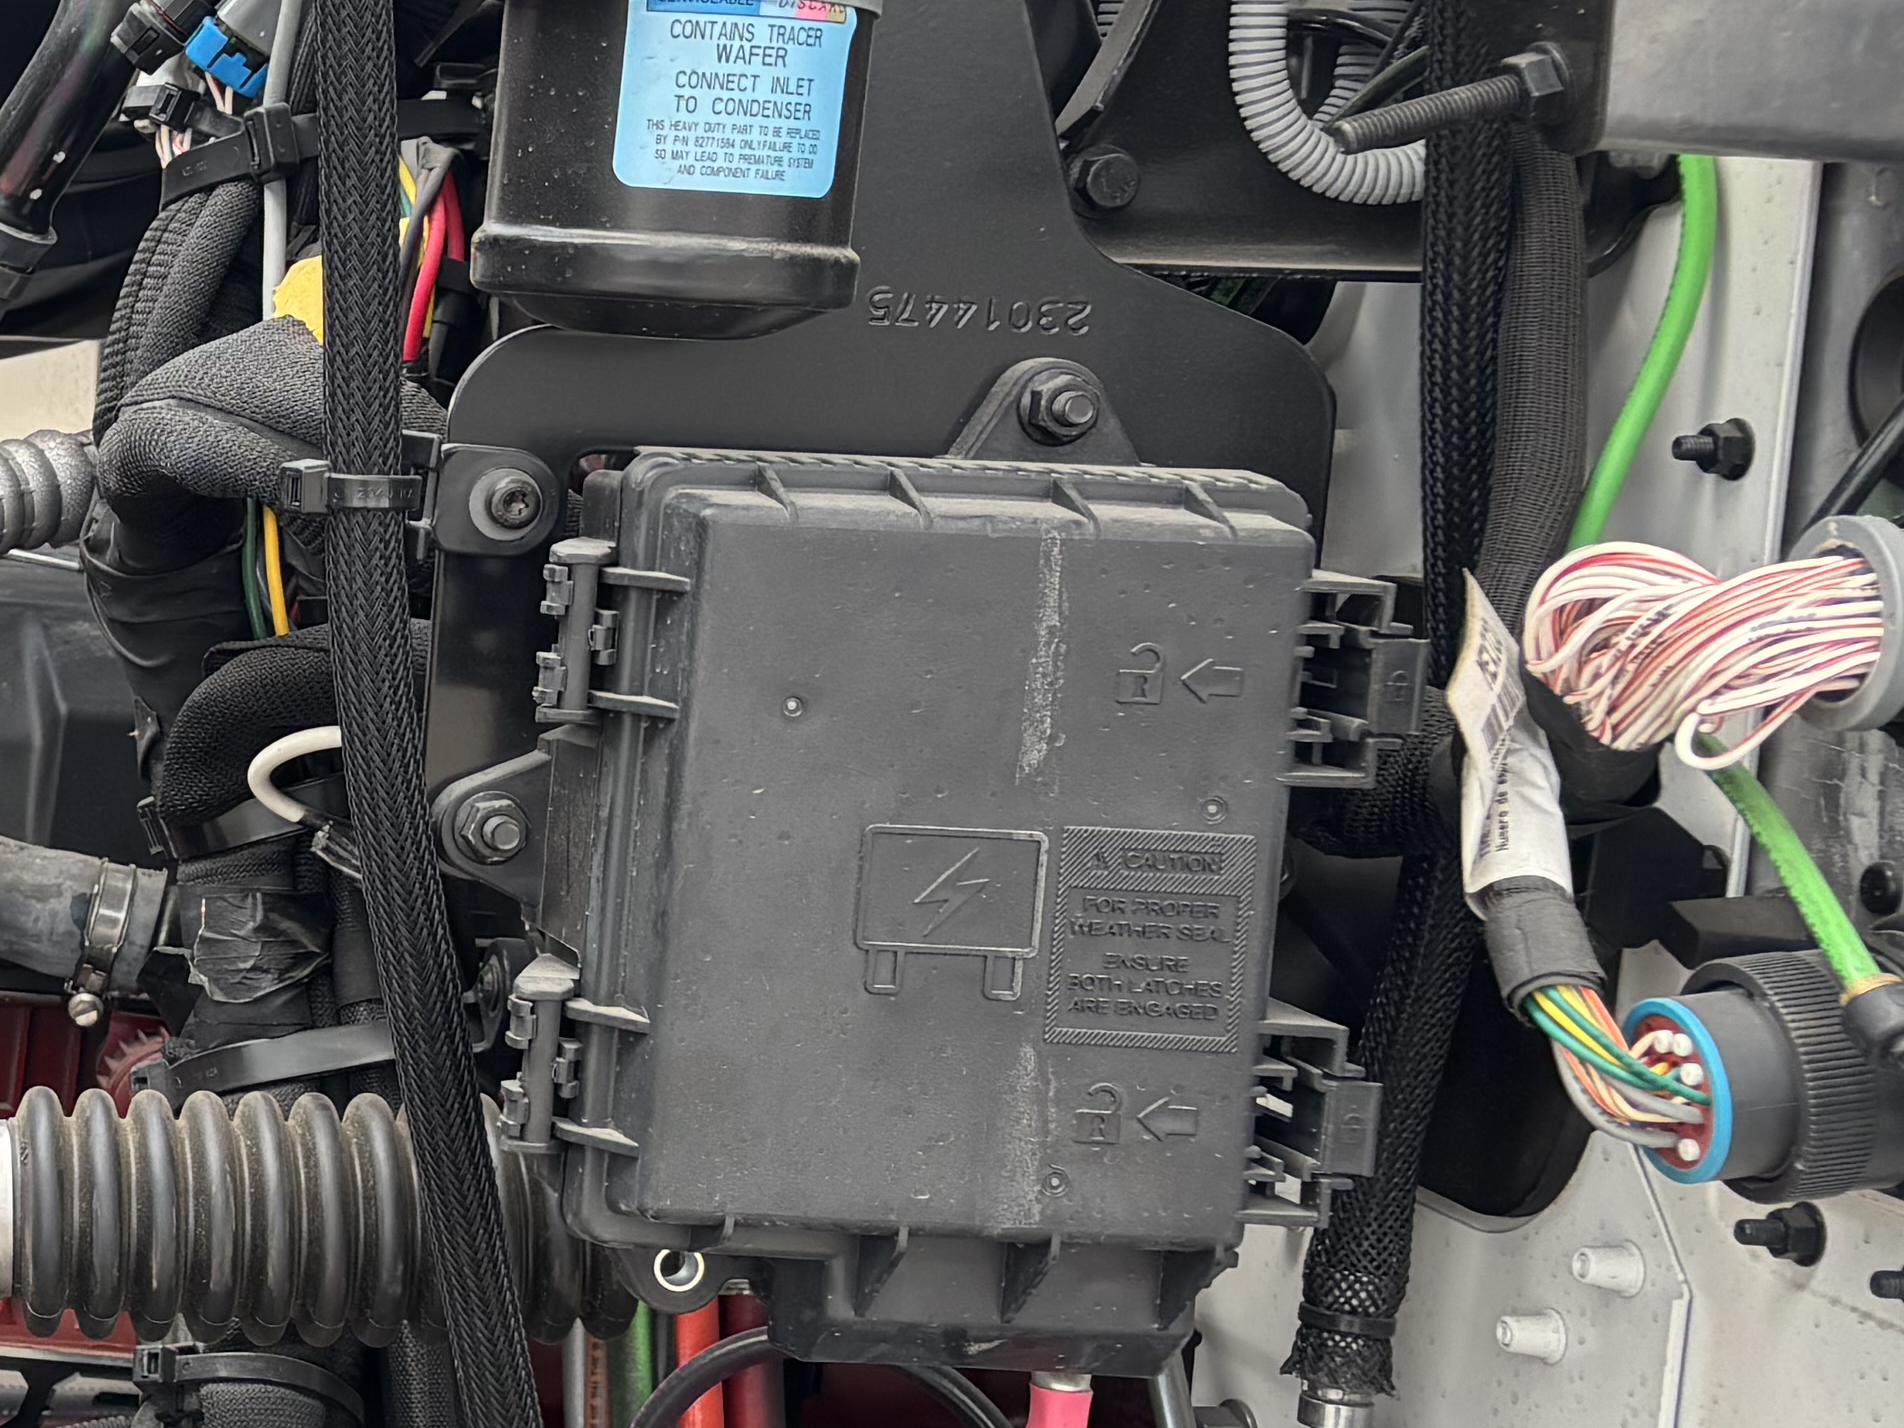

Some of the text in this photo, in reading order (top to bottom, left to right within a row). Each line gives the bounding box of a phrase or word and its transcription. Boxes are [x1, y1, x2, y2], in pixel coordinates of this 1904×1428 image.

[670, 19, 823, 48] CONTAINS TRACER
[717, 44, 789, 68] WAFER
[675, 70, 815, 97] CONNECT INLET
[674, 95, 812, 121] TO CONDENSER
[647, 119, 665, 131] THIS
[669, 120, 699, 132] HEAVY
[704, 122, 727, 134] DUTY
[731, 124, 754, 136] PART
[759, 125, 770, 137] TO
[772, 126, 783, 138] BE
[655, 134, 668, 145] BY
[655, 148, 666, 160] SO
[671, 150, 690, 161] MAY
[694, 151, 718, 163] LEAD
[723, 152, 734, 164] TO
[738, 153, 784, 167] PREMATURE
[677, 164, 786, 181] AND COMPONENT FAILURE
[867, 285, 1092, 335] 23014475
[1123, 851, 1221, 873] CAUTION
[1083, 895, 1220, 919] FOR PROPER
[1069, 918, 1231, 943] WEATHER SEAL
[1103, 952, 1189, 973] ENSURE
[1068, 973, 1223, 998] BOTH LATCHES
[1068, 997, 1219, 1020] ARE ENGAGED
